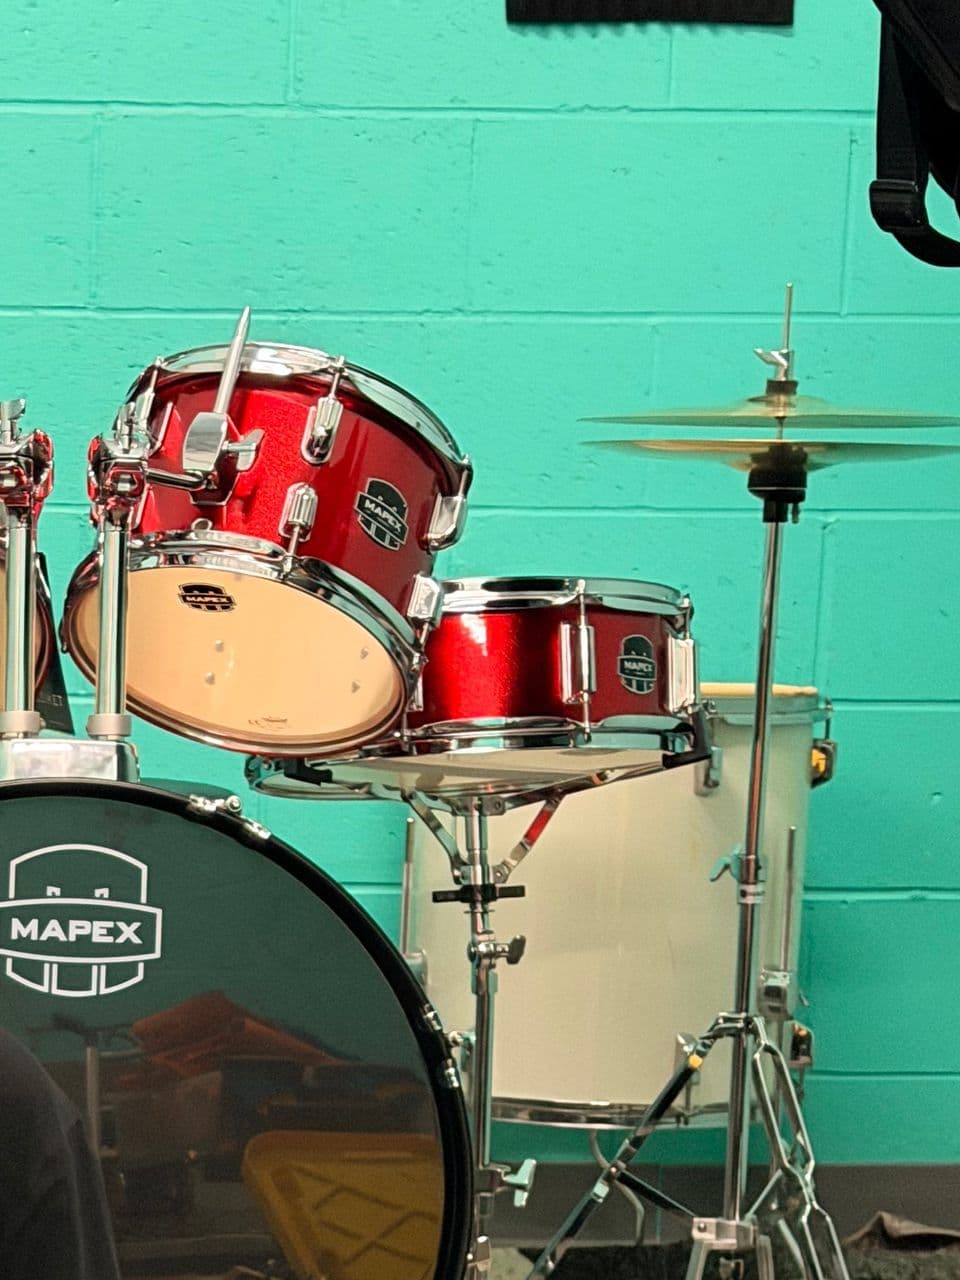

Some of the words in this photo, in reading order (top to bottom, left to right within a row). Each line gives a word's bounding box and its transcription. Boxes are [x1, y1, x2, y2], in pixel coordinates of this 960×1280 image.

[364, 499, 402, 532] MAPEX
[623, 660, 653, 672] MAPEX
[10, 917, 143, 944] MAPEX
